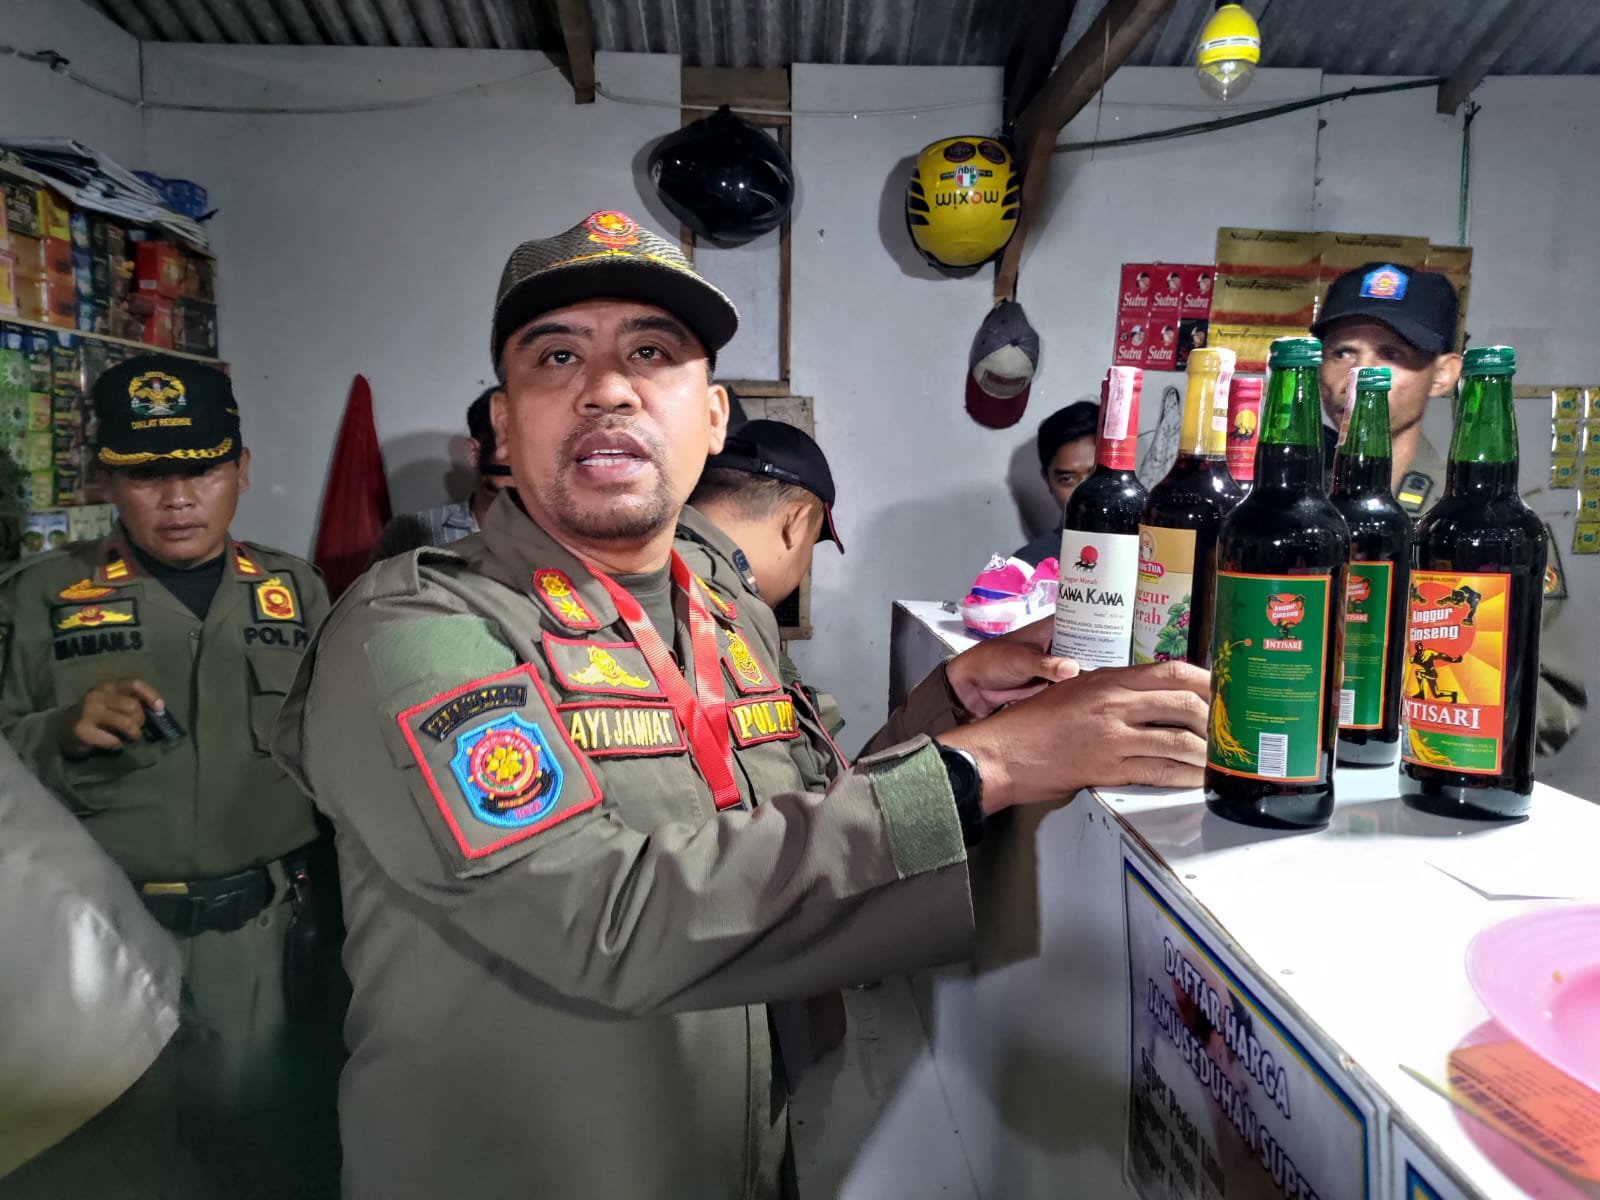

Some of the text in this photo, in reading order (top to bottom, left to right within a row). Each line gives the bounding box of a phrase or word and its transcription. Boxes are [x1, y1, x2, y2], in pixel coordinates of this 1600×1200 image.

[1122, 292, 1148, 307] Sutra
[1153, 292, 1179, 307] Sutra
[1184, 293, 1209, 308] Sutra
[1117, 345, 1143, 360] Sutra
[1147, 345, 1173, 360] Sutra
[1086, 588, 1124, 607] KAWA
[243, 627, 290, 646] POL
[1265, 640, 1302, 650] INTISARI
[733, 703, 776, 739] POL
[1403, 699, 1481, 730] NTISARI
[1163, 936, 1291, 1120] DAFTAR HARGA
[1148, 978, 1181, 1049] JAMU
[1181, 1028, 1257, 1153] SEDUHAN
